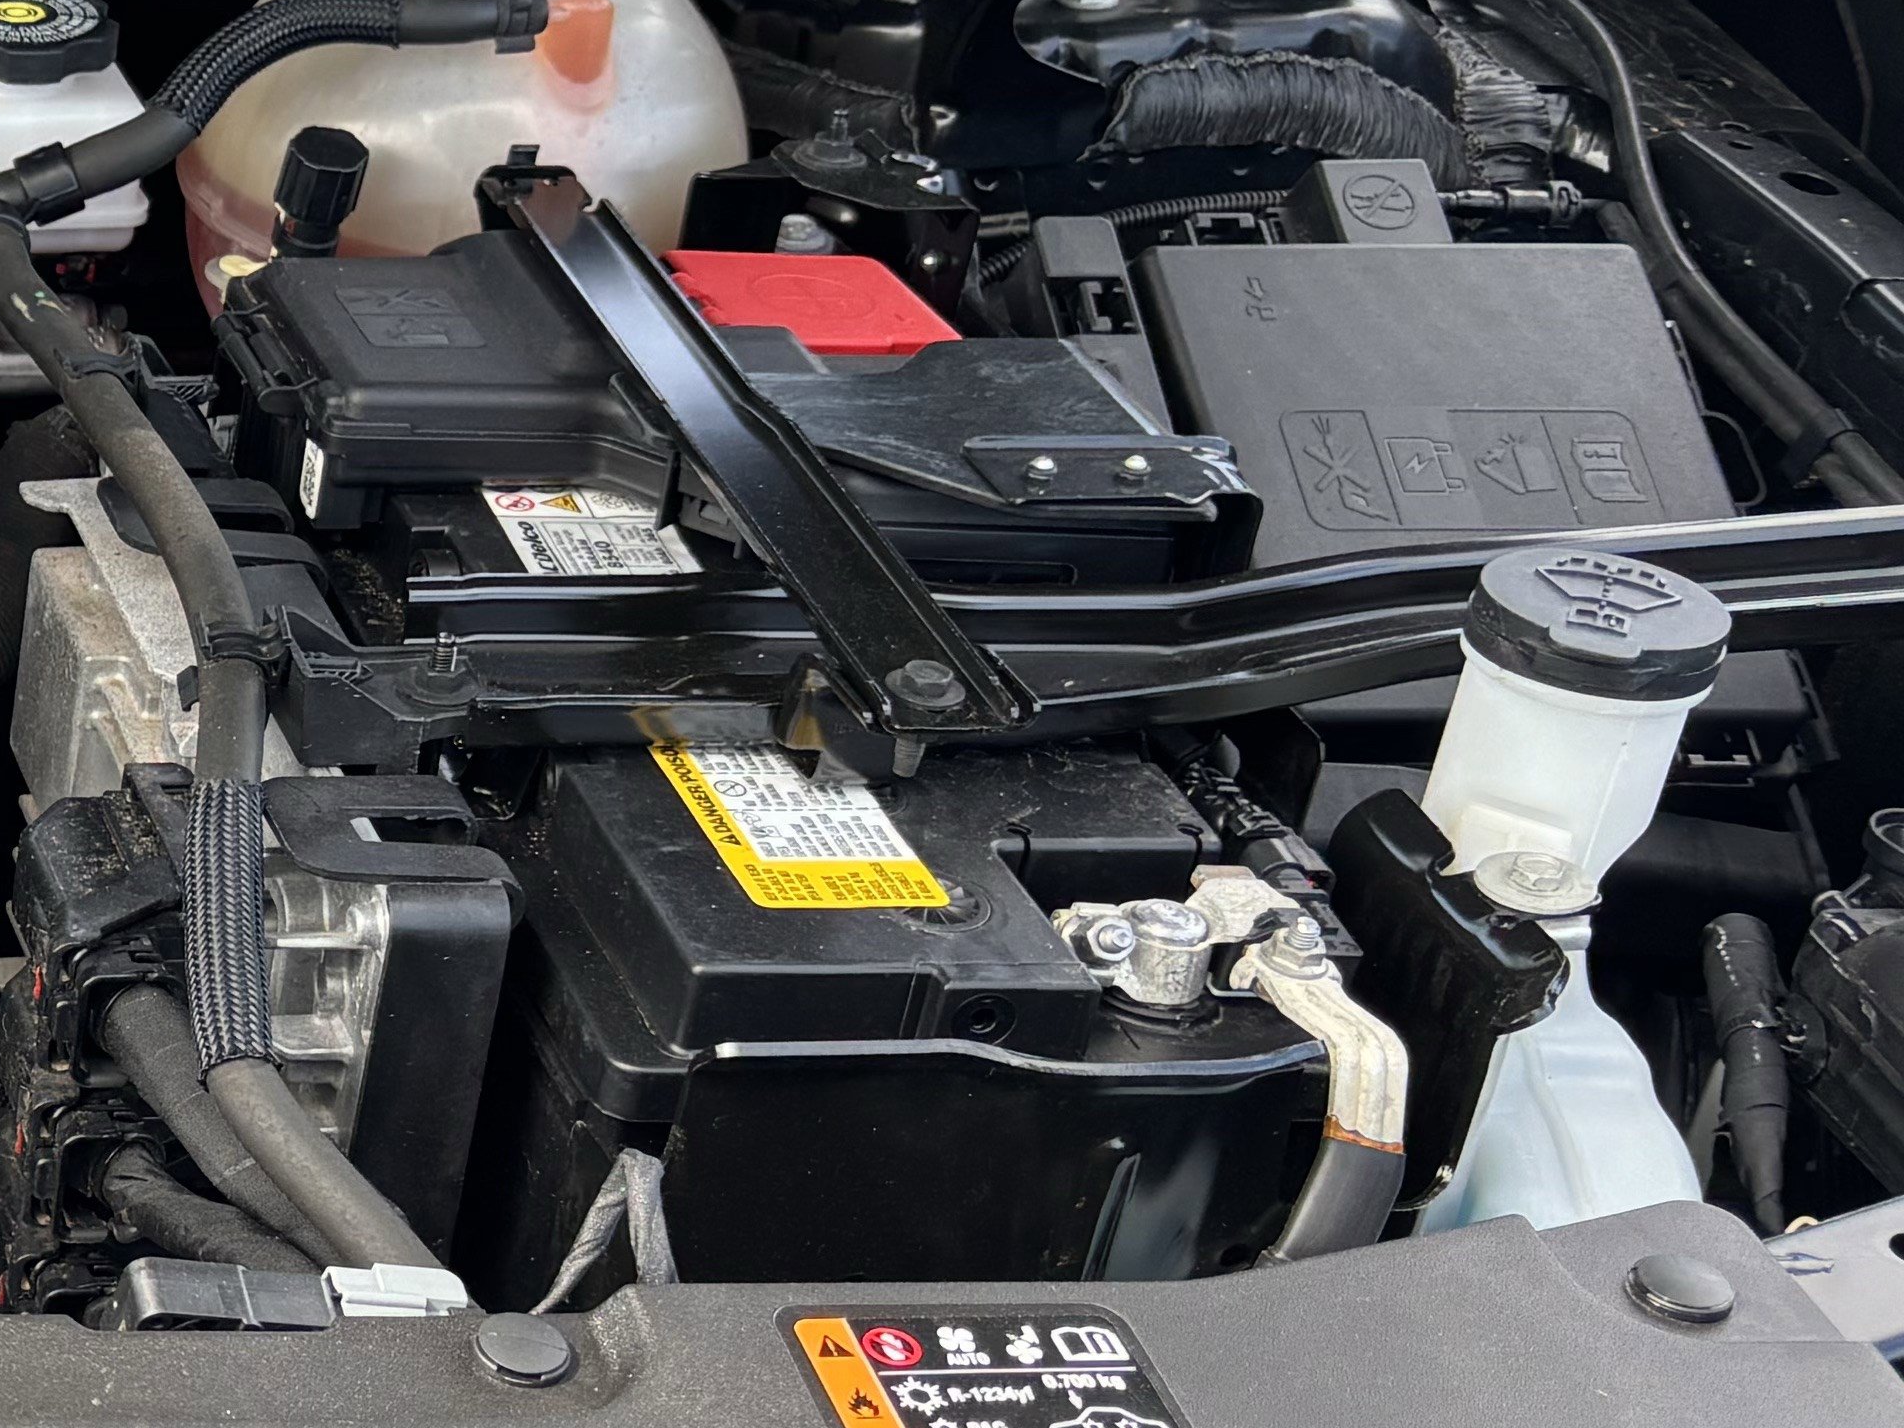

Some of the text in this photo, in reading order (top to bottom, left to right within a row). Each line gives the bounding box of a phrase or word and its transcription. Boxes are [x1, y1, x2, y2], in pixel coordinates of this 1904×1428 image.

[517, 521, 562, 573] CDelco
[659, 746, 732, 834] DANGER/POISO
[946, 1351, 991, 1366] AUTO
[1041, 1373, 1127, 1390] 0.700 kg
[946, 1385, 1036, 1405] R-1234yf
